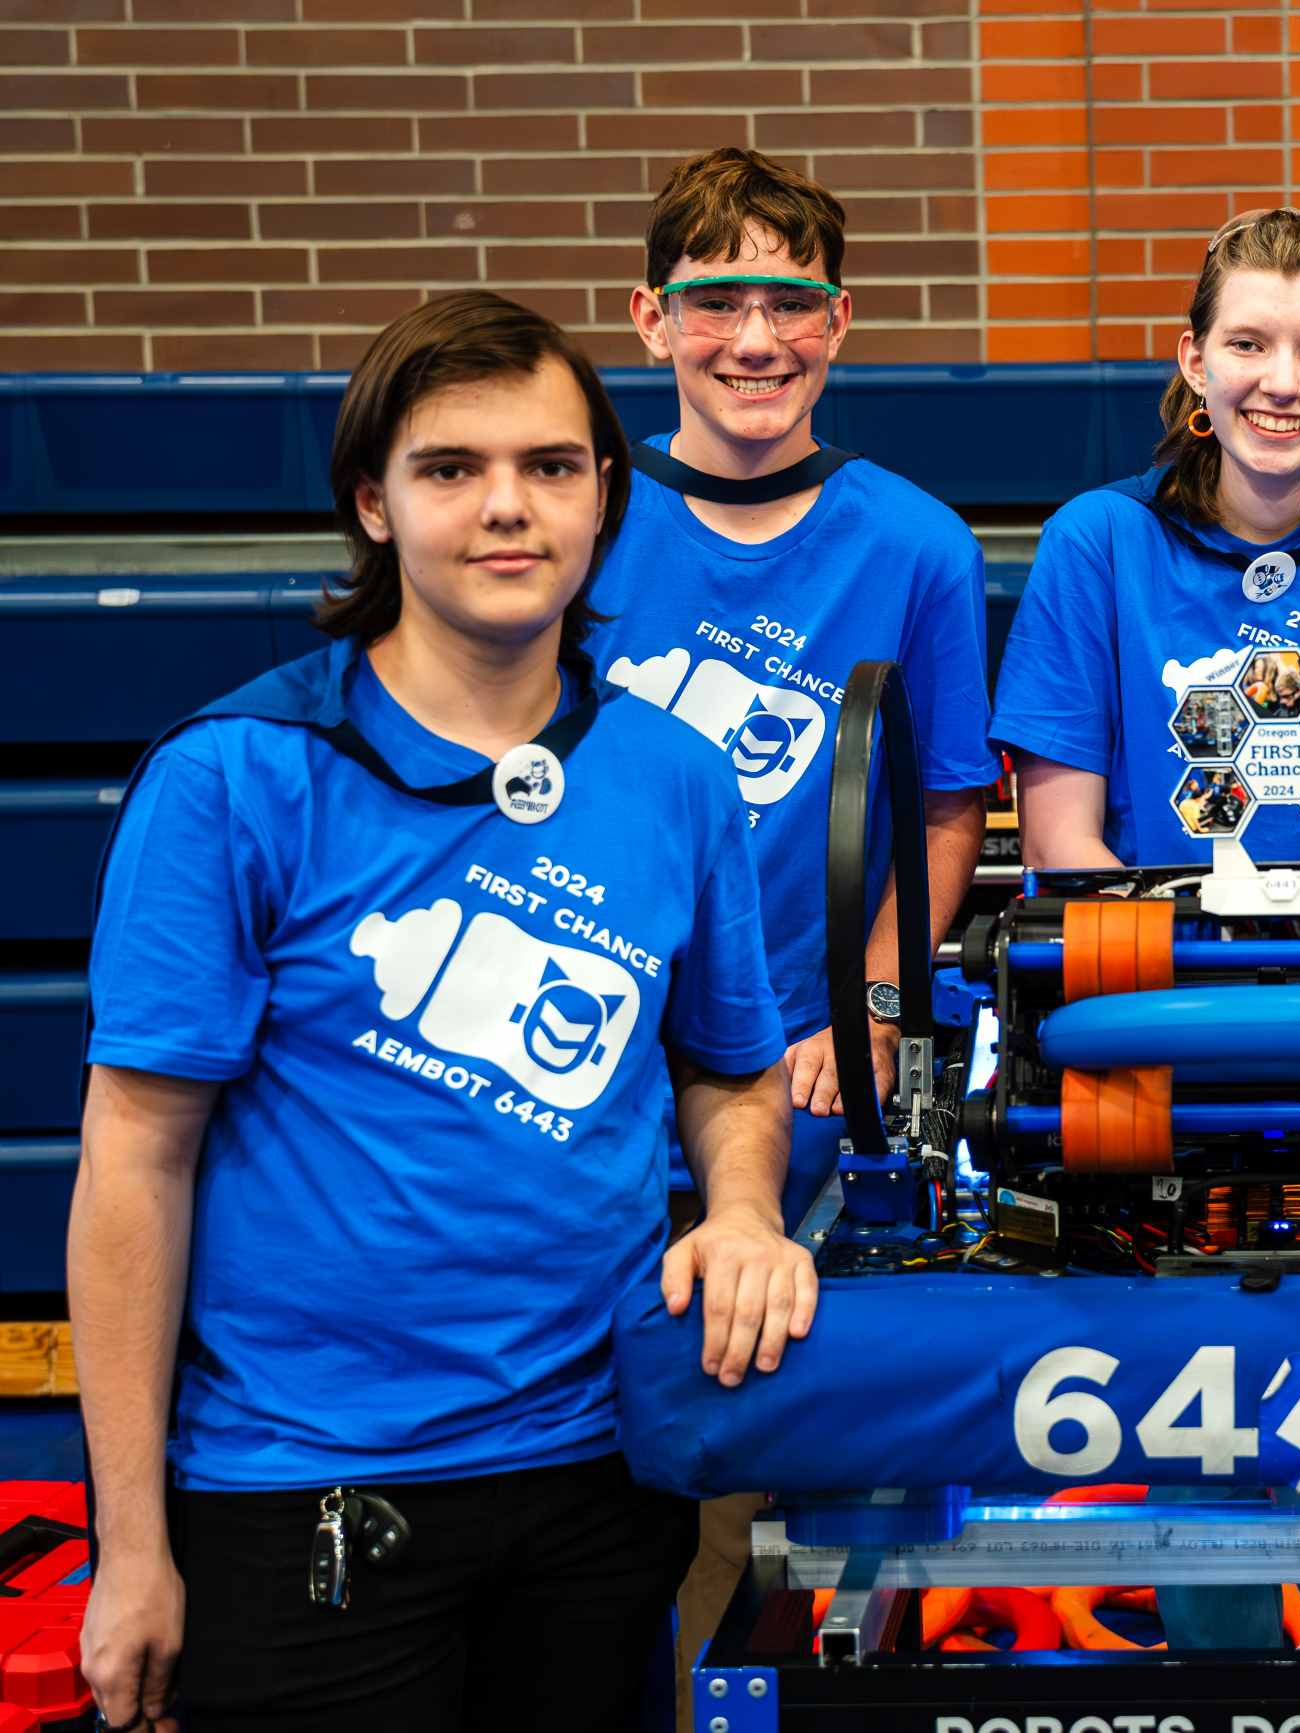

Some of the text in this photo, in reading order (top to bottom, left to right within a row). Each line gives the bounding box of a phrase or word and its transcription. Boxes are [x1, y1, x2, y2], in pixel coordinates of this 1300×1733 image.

[750, 615, 809, 652] 2024
[695, 621, 846, 705] FIRST CHANCE
[1257, 728, 1298, 738] Oregon
[1263, 785, 1295, 796] 2024
[530, 856, 608, 906] 2024
[464, 863, 662, 978] FIRST CHANCE
[352, 1029, 575, 1143] AEMBOT 6443
